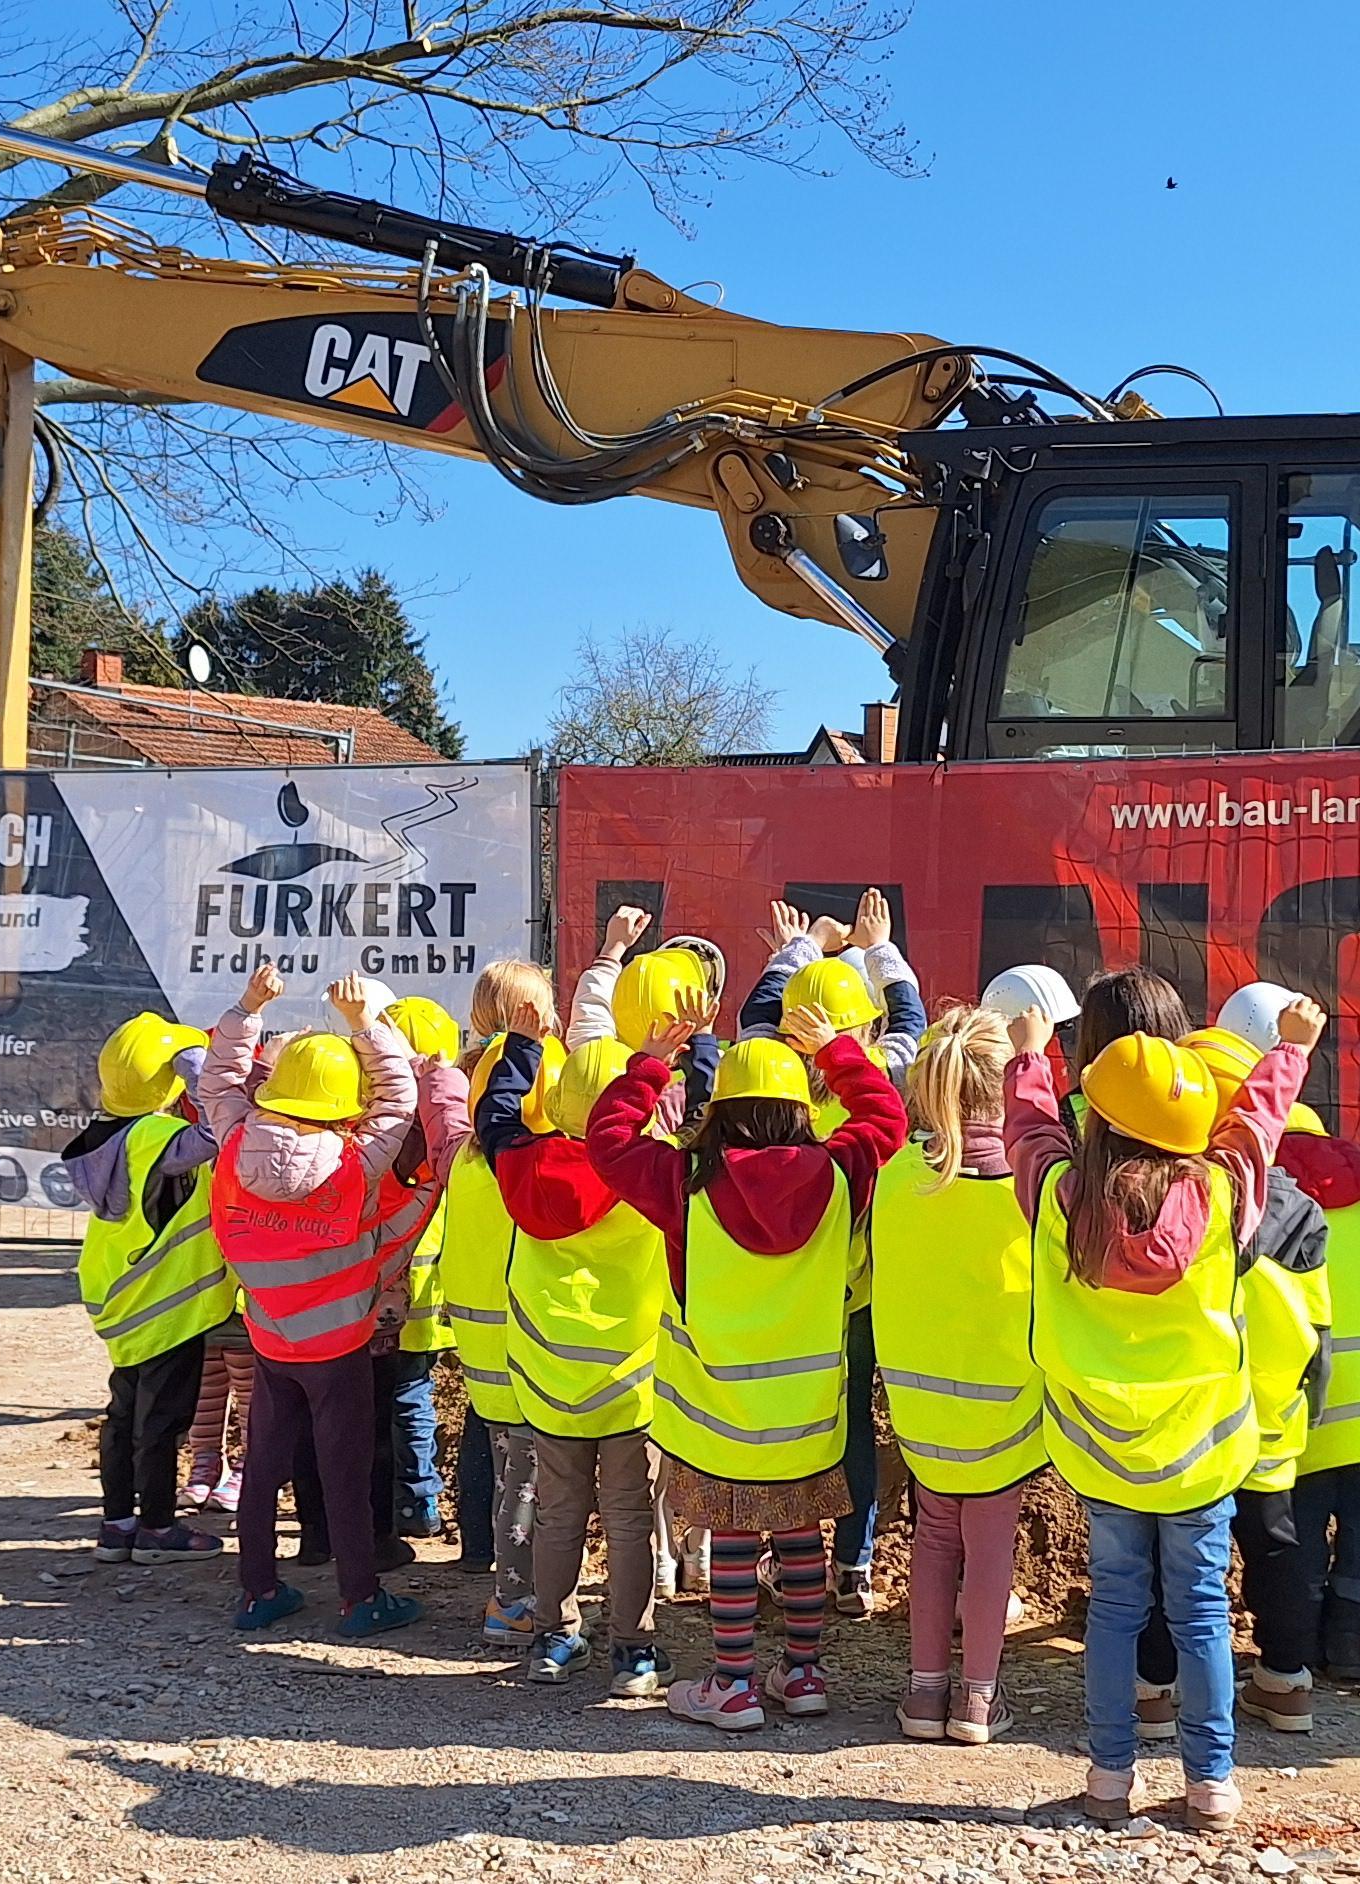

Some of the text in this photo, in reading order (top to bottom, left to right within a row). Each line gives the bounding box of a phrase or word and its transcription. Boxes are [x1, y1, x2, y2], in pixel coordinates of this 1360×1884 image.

[304, 323, 432, 417] CAT
[193, 882, 477, 939] FURKERT
[189, 944, 476, 974] Erdbau GmbH
[248, 1209, 331, 1238] Hello Kitty
